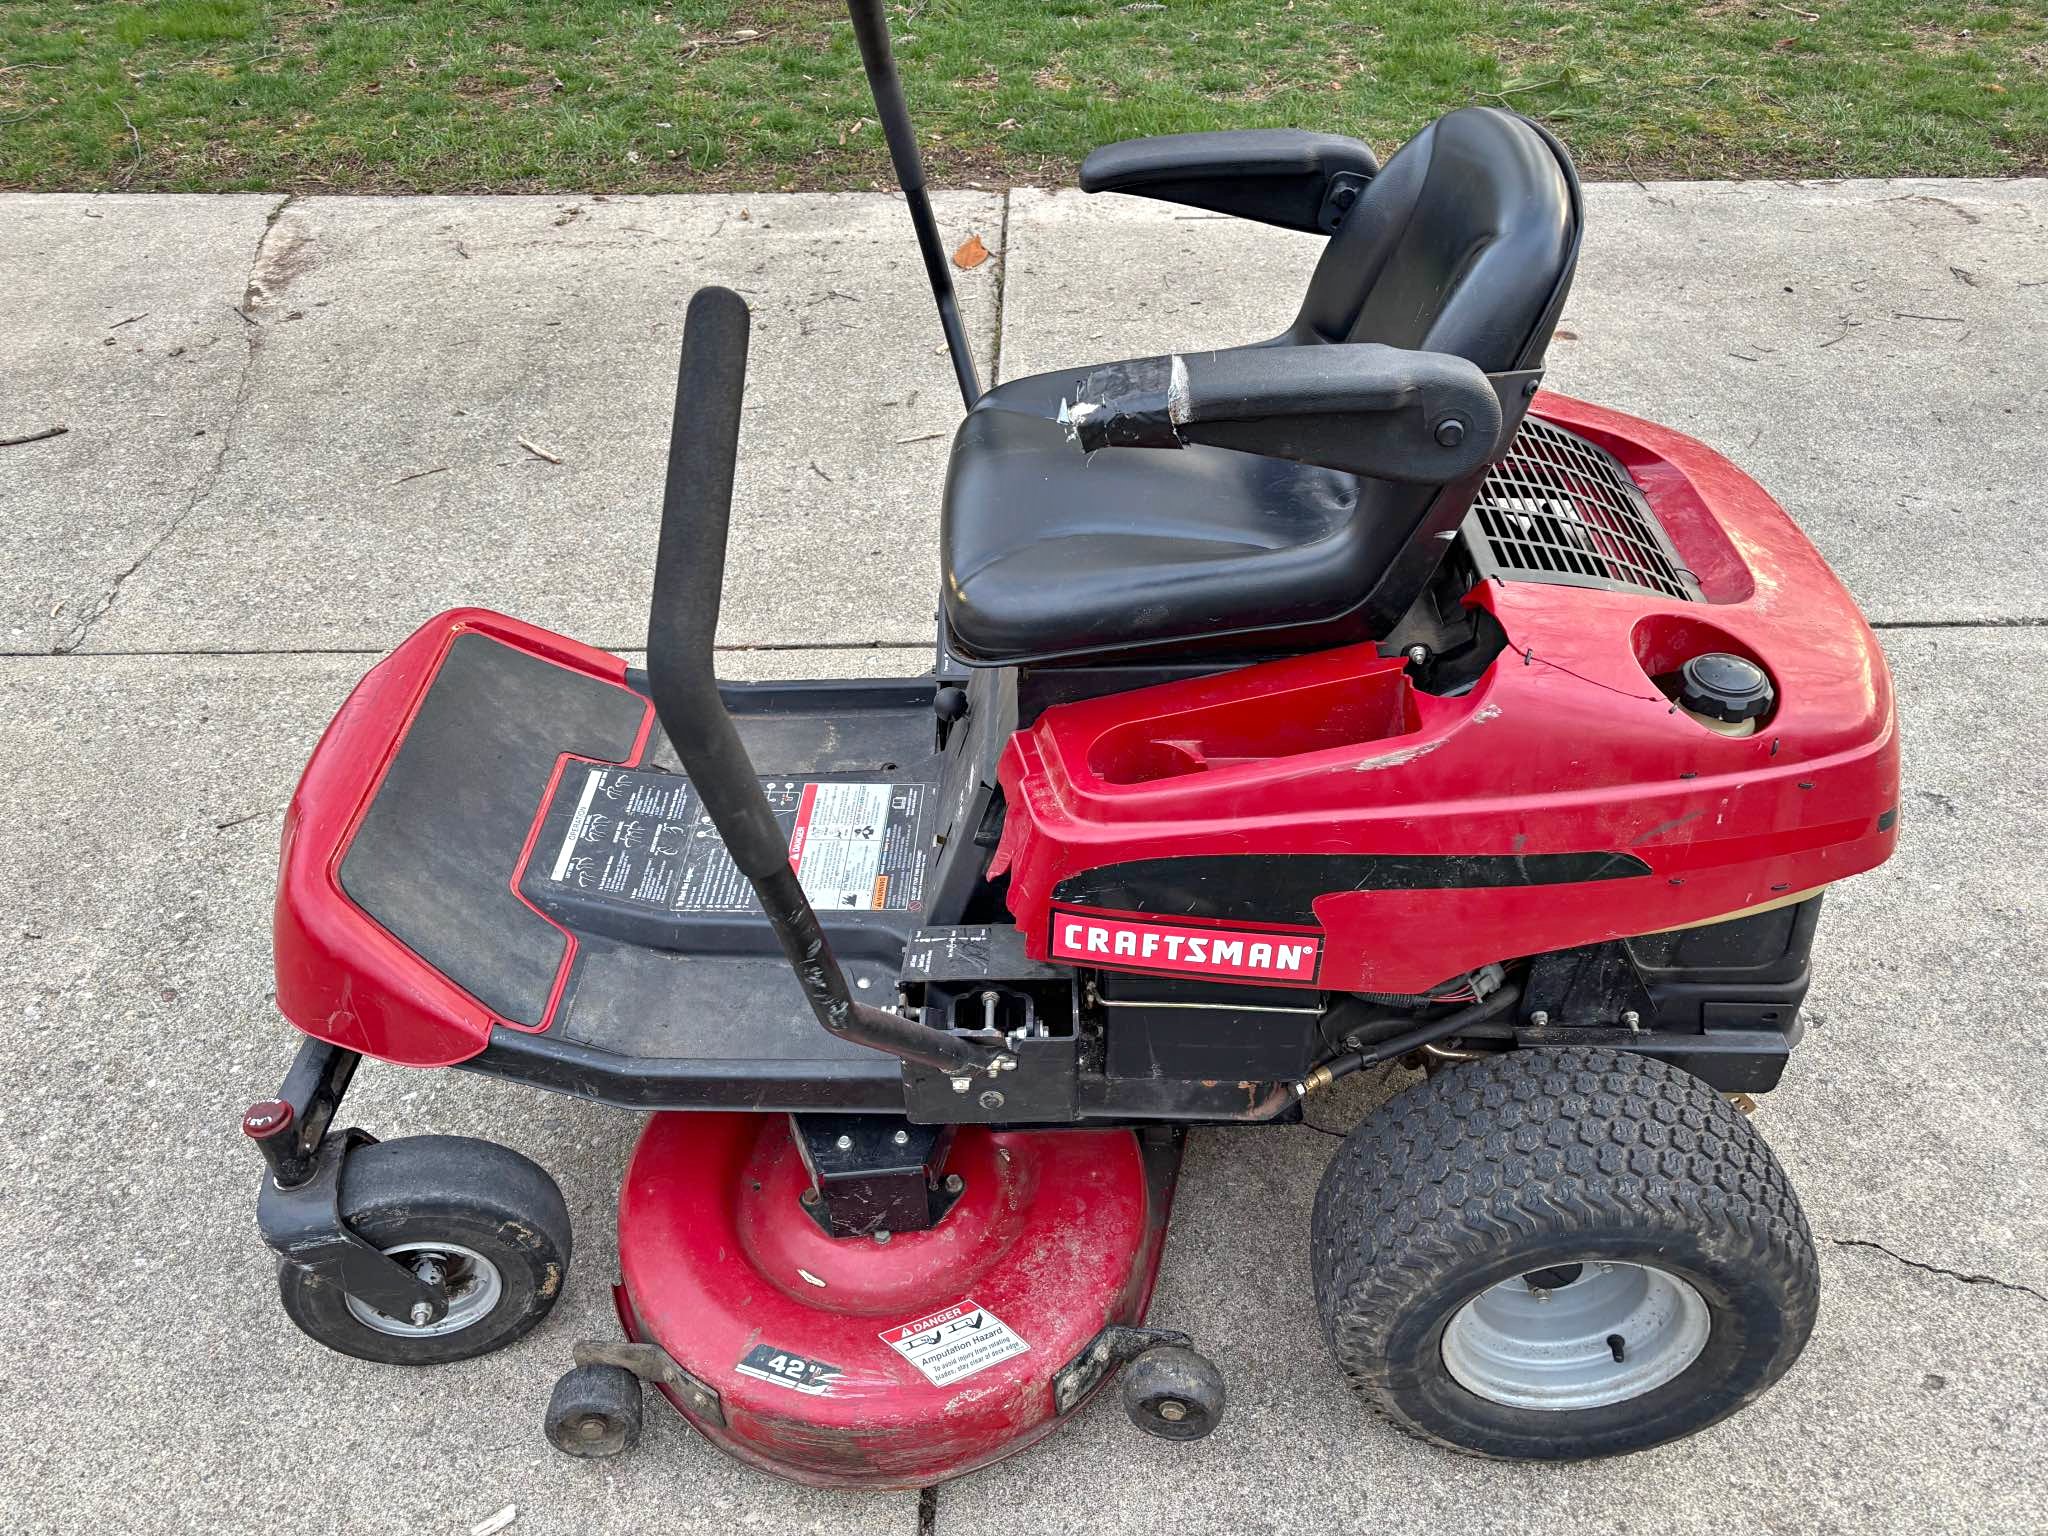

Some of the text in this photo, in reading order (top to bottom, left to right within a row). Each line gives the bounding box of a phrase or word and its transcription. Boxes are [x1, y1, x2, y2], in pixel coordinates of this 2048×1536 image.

[568, 806, 586, 840] OPERATION
[792, 825, 804, 854] DANGER
[1064, 923, 1303, 971] CRAFTSMAN
[914, 1308, 961, 1331] DANGER
[922, 1327, 1003, 1366] Amputation Hazard
[941, 1358, 957, 1369] avoid
[958, 1352, 974, 1364] injury
[975, 1346, 987, 1355] from
